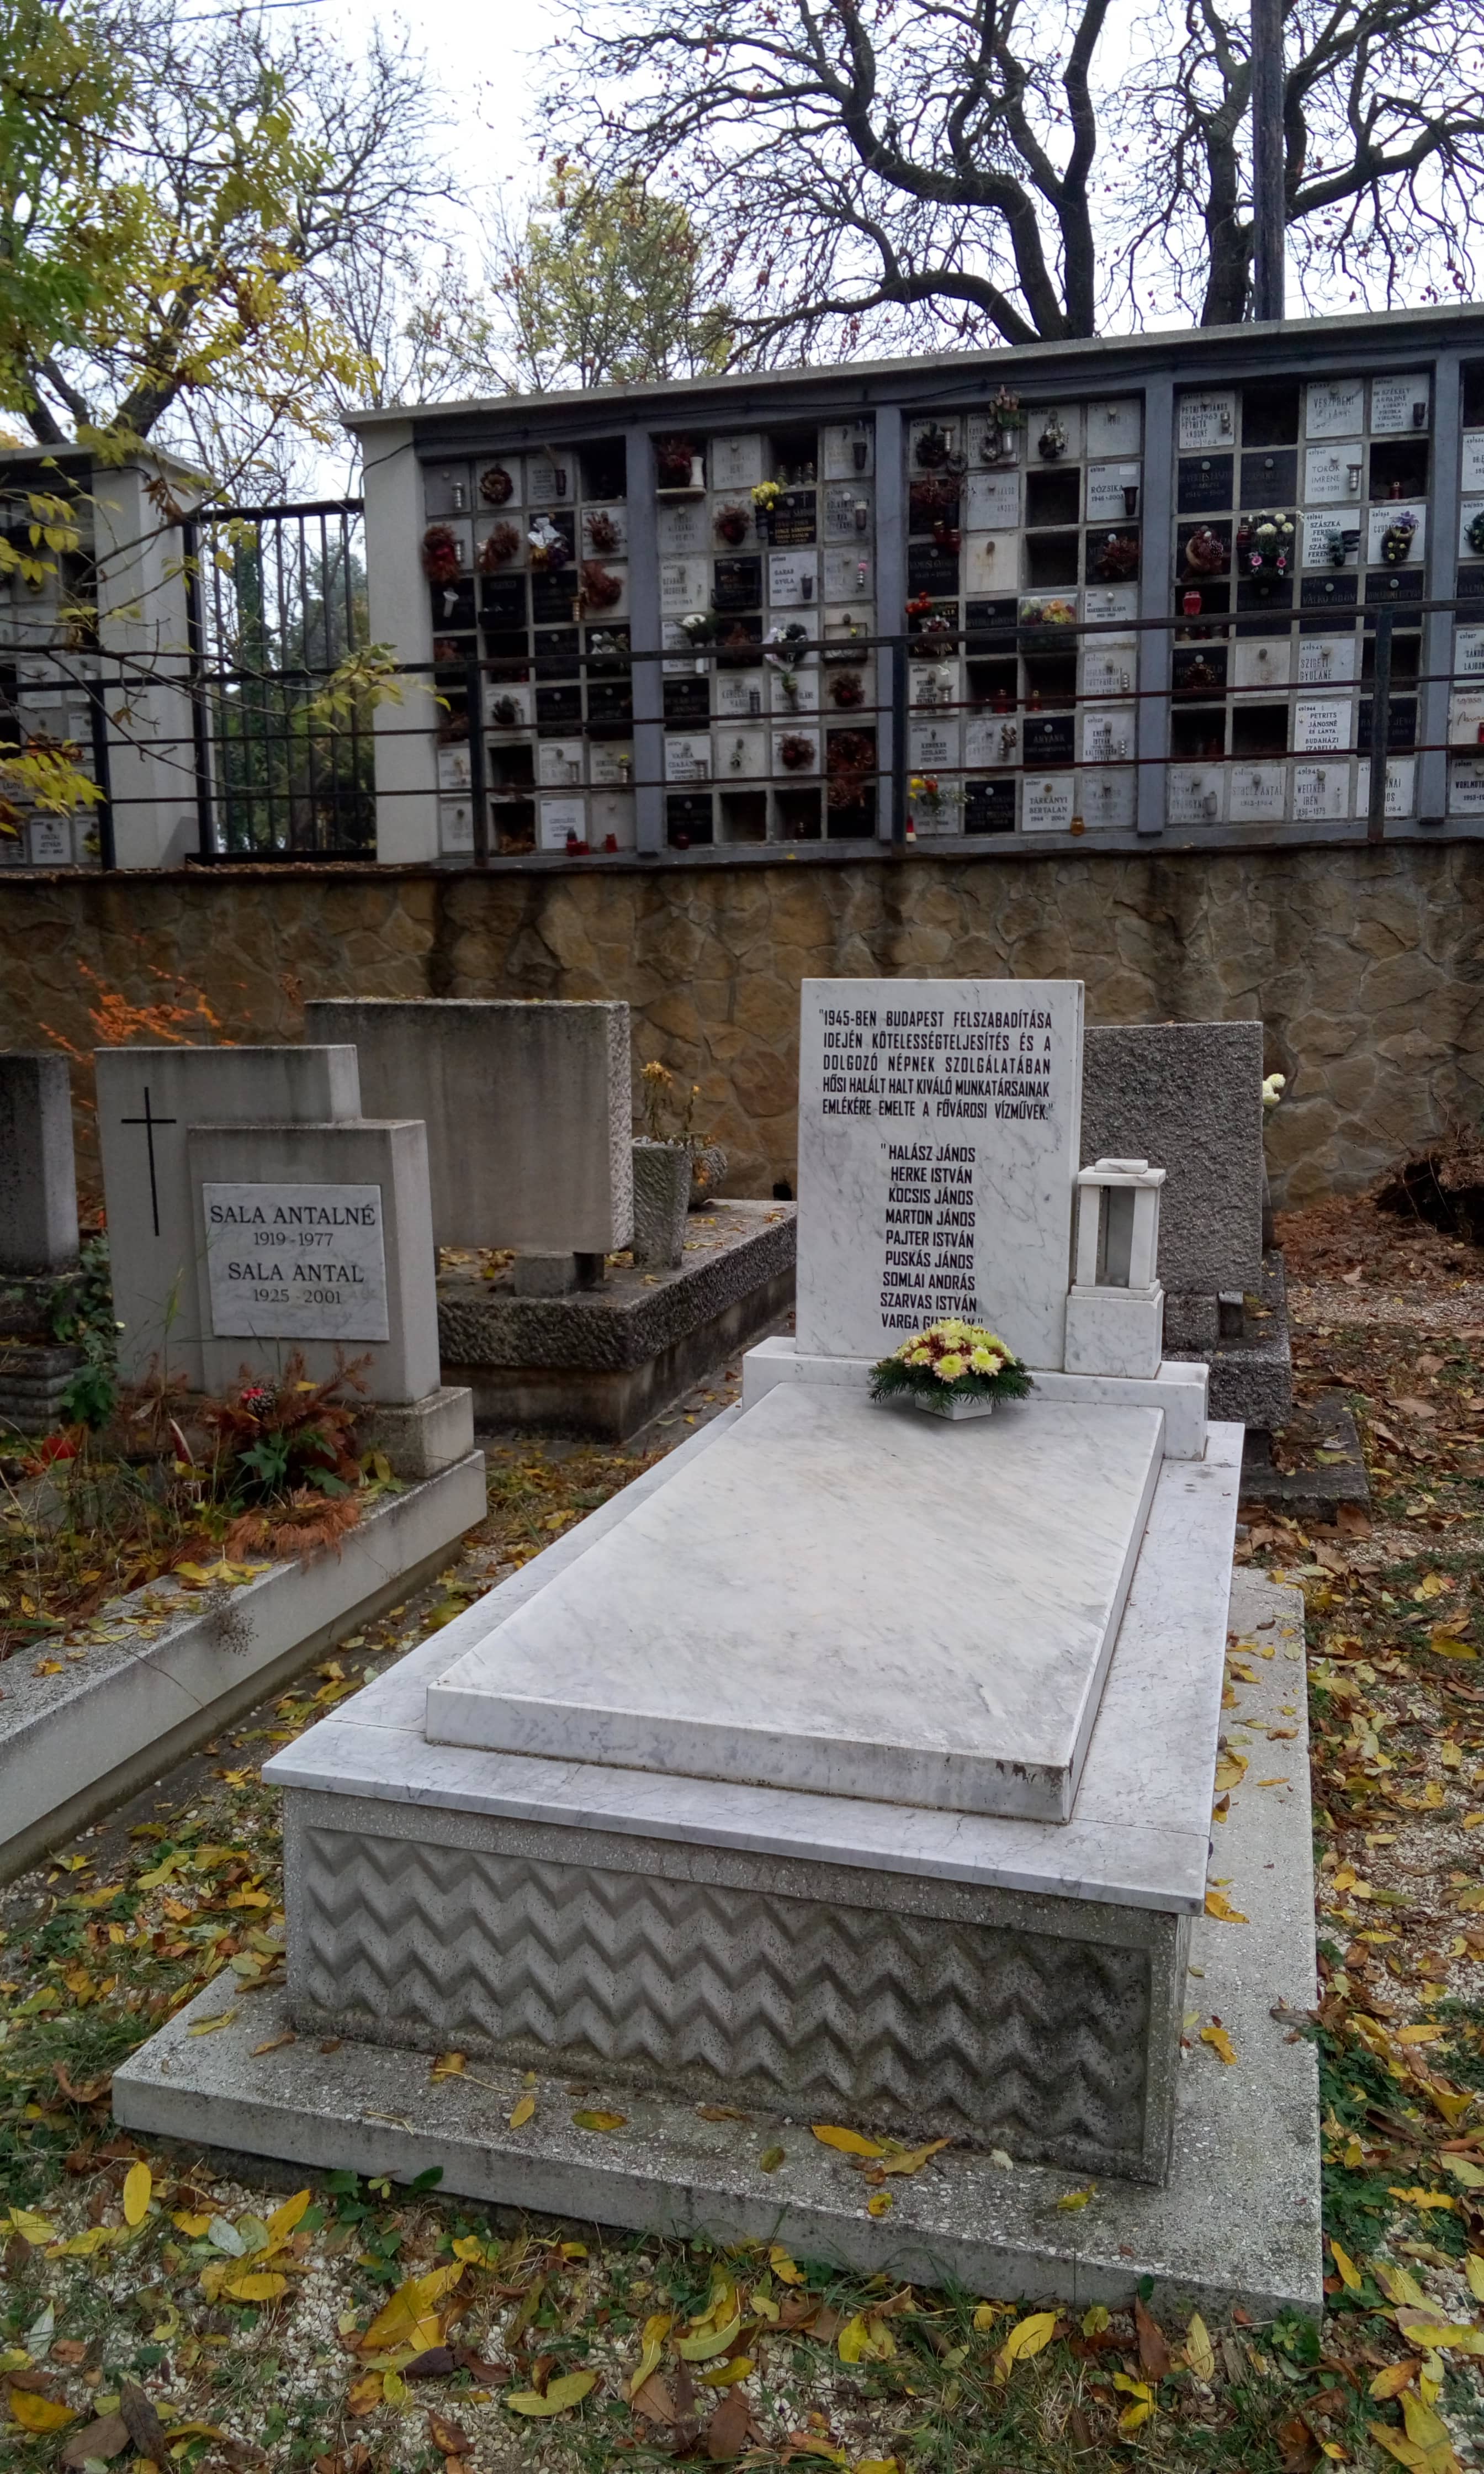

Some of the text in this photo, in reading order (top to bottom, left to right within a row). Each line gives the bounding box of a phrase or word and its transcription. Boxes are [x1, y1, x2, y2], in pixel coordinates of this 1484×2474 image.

[886, 1011, 944, 1027] BUDAPEST
[953, 1009, 1052, 1029] FELSZABADÍTÁSA
[824, 1030, 1051, 1051] IDEJÉN KÖTELESSÉGTELJESÍTÉS ÉS A
[823, 1052, 1050, 1075] DOLGOZÓ NÉPNEK SZOLGÁLATÁBAN
[823, 1075, 1050, 1097] HŐSI HALÁLT HALT KIVÁLÓ MUNKATÁRSAINAK
[823, 1097, 872, 1116] EMLÉKÉRE
[878, 1101, 915, 1117] EMELTE
[923, 1101, 929, 1117] A
[936, 1099, 987, 1119] FŐVÁROSI
[936, 1143, 976, 1162] JÁNOS
[891, 1166, 972, 1184] HERKE ISTVÁN
[888, 1187, 974, 1206] KOCSIS JÁNOS
[210, 1204, 376, 1225] SALA ANTALNÉ
[886, 1208, 976, 1227] MARTON JÁNOS
[886, 1230, 974, 1249] PAJTER ISTVÁN
[885, 1249, 974, 1270] PUSKÁS JÁNOS
[228, 1262, 364, 1282] SALA ANTAL
[882, 1271, 975, 1291] SOMLAI ANDRÁS
[880, 1292, 977, 1313] SZARVAS ISTVÁN
[881, 1313, 919, 1330] VARGA
